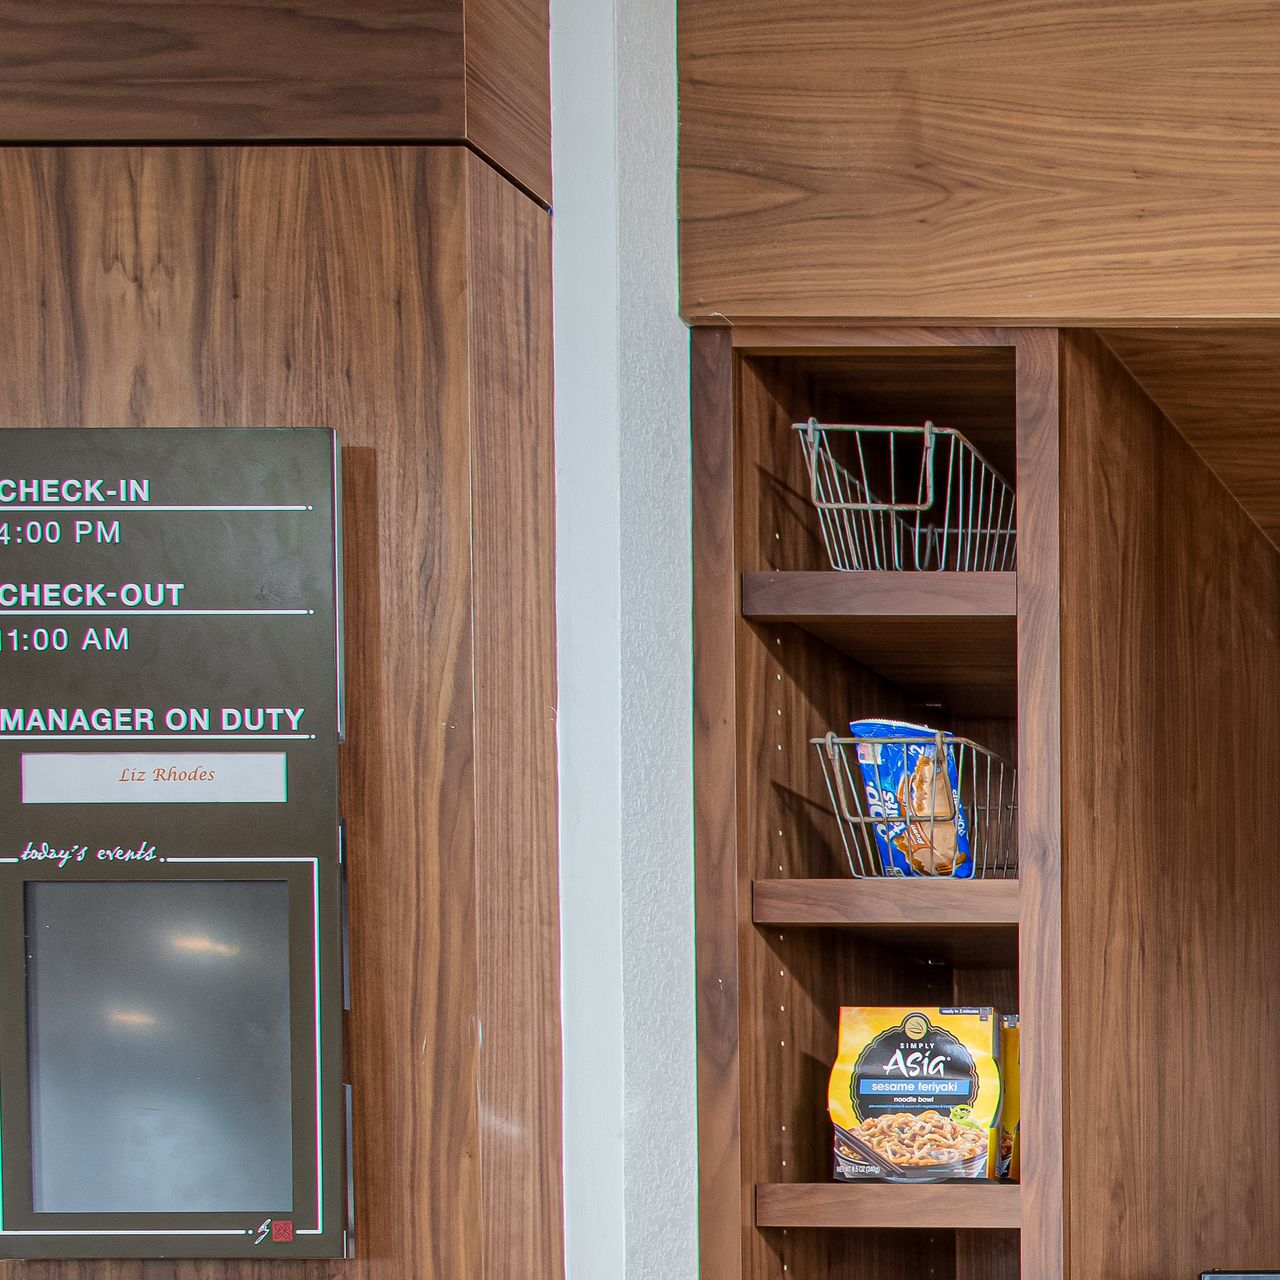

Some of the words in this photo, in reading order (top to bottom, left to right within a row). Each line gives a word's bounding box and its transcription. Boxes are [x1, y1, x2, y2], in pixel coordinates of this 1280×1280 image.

[0, 479, 150, 502] CHECK-IN
[0, 521, 61, 544] 4:00
[75, 521, 121, 544] PM
[0, 584, 184, 606] CHECK-OUT
[82, 628, 130, 650] AM
[0, 708, 154, 731] MANAGER
[166, 708, 210, 731] ON
[221, 708, 304, 731] DUTY
[118, 767, 146, 782] Liz
[153, 765, 215, 782] Rhodes
[883, 1049, 946, 1078] Asia
[871, 1082, 915, 1091] sesame
[917, 1081, 957, 1093] teriyaki
